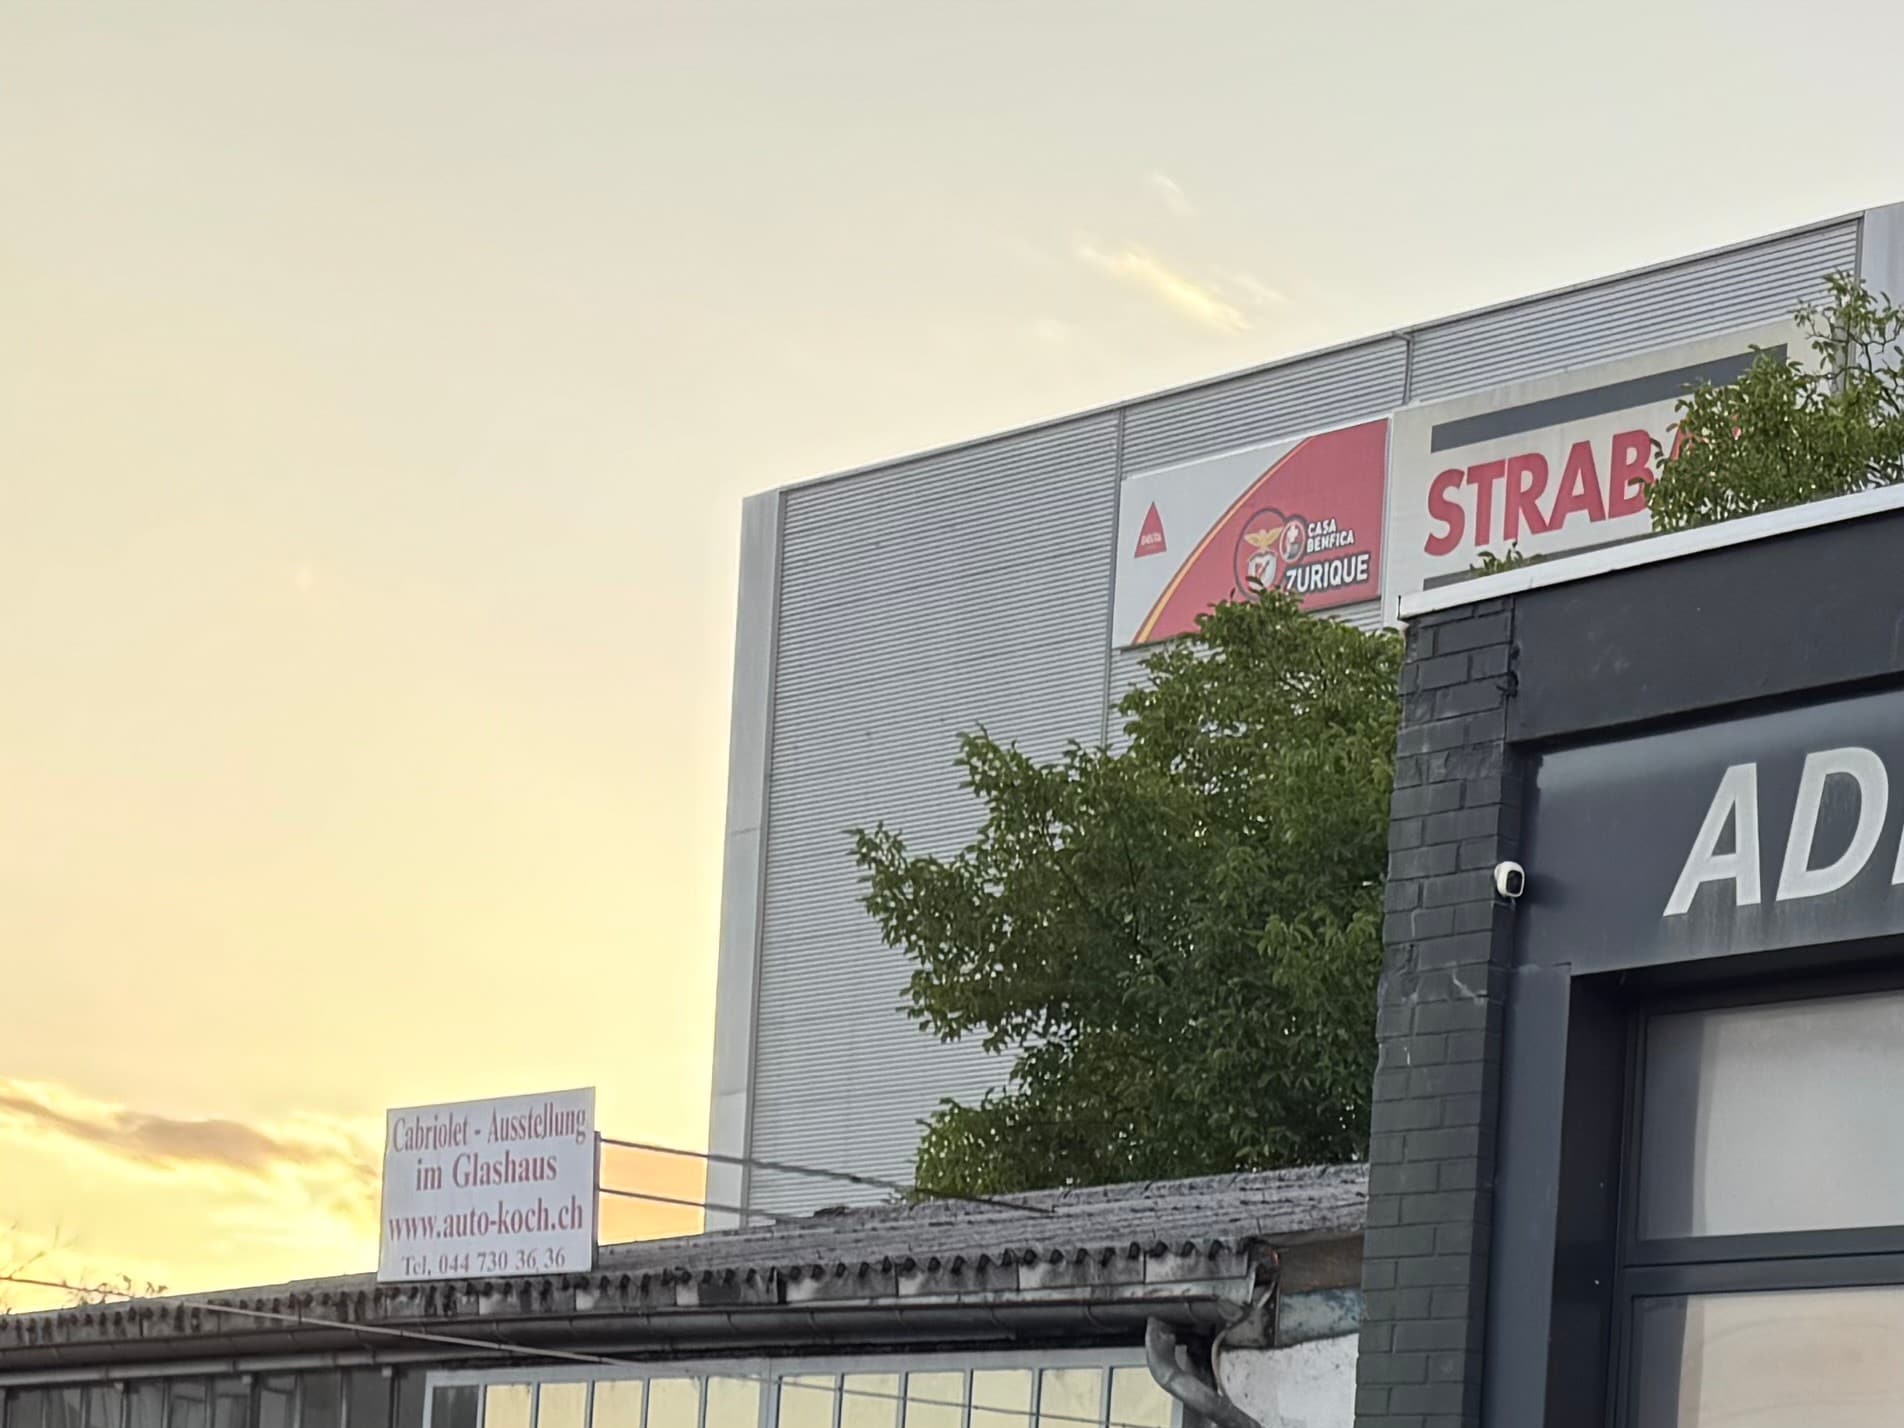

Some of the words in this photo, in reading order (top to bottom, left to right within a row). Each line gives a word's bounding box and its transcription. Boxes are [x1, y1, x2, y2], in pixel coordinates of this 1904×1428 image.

[1423, 418, 1710, 558] STRAB
[1306, 530, 1354, 553] BENFICA
[1308, 518, 1337, 537] CASA
[1286, 553, 1369, 593] ZURIQUE
[393, 1113, 469, 1152] Cabriolet
[487, 1102, 586, 1145] Ausstellung
[416, 1158, 442, 1192] im
[452, 1150, 558, 1189] Glashaus
[389, 1195, 583, 1241] www.auto-koch.ch
[439, 1254, 469, 1274] 044
[476, 1250, 508, 1273] 730
[544, 1247, 566, 1270] 36
